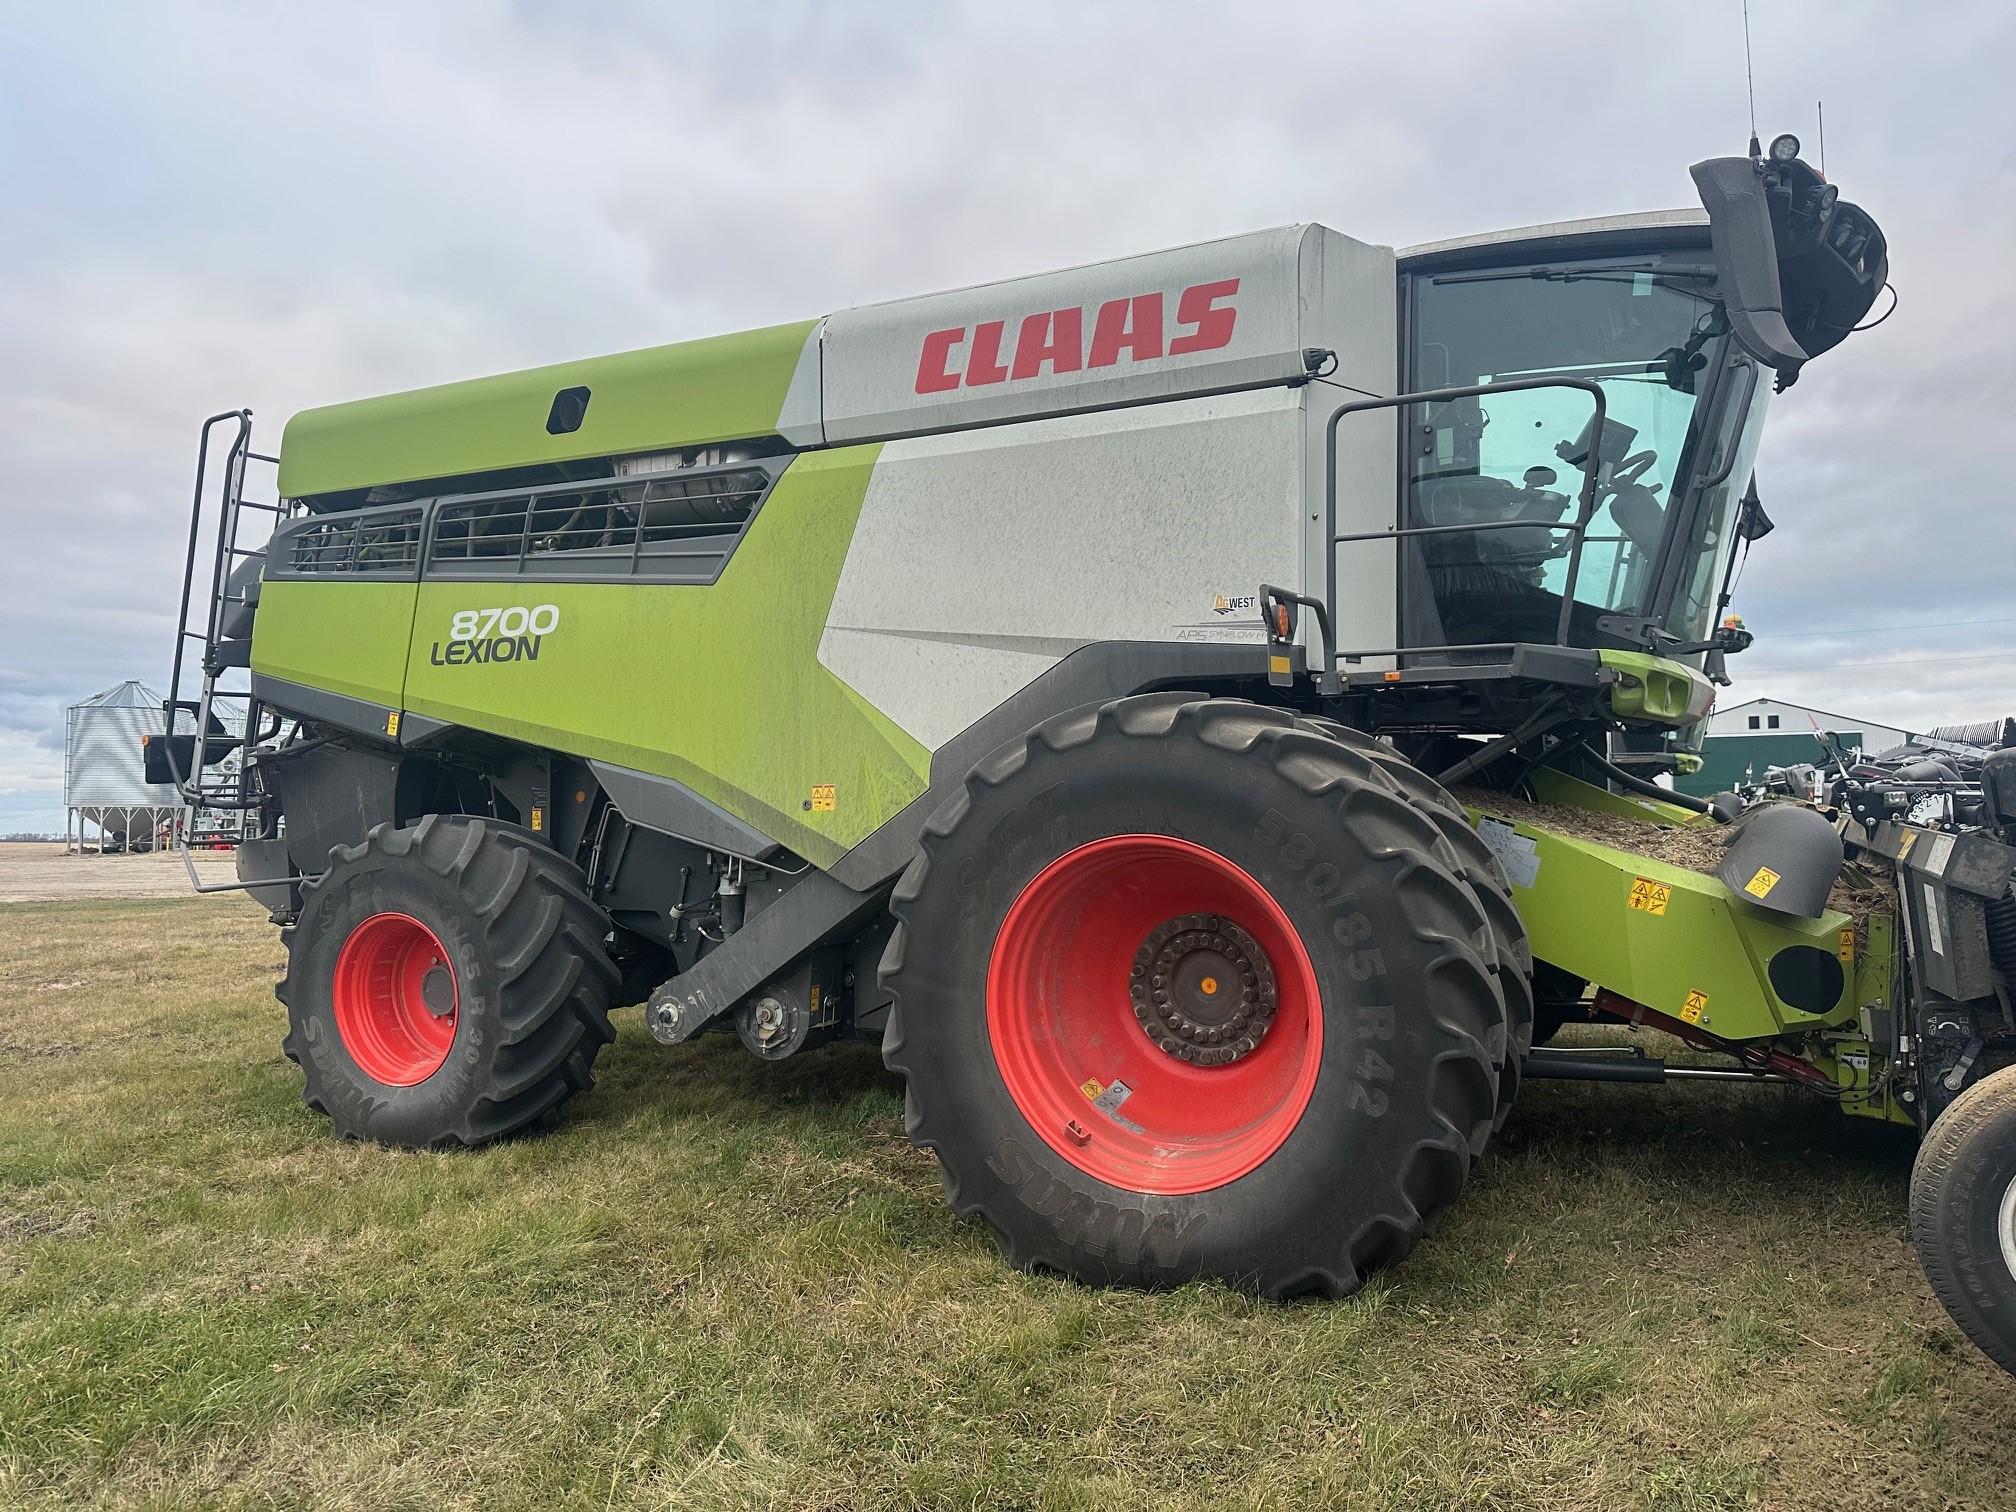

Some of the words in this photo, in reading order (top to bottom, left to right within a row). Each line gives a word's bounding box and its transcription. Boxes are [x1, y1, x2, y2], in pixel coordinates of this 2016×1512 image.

[914, 278, 1241, 395] CLAAS
[450, 604, 560, 640] 8700
[1176, 629, 1208, 641] APS
[1209, 630, 1255, 639] SYNFLOW
[430, 635, 542, 666] LEXION
